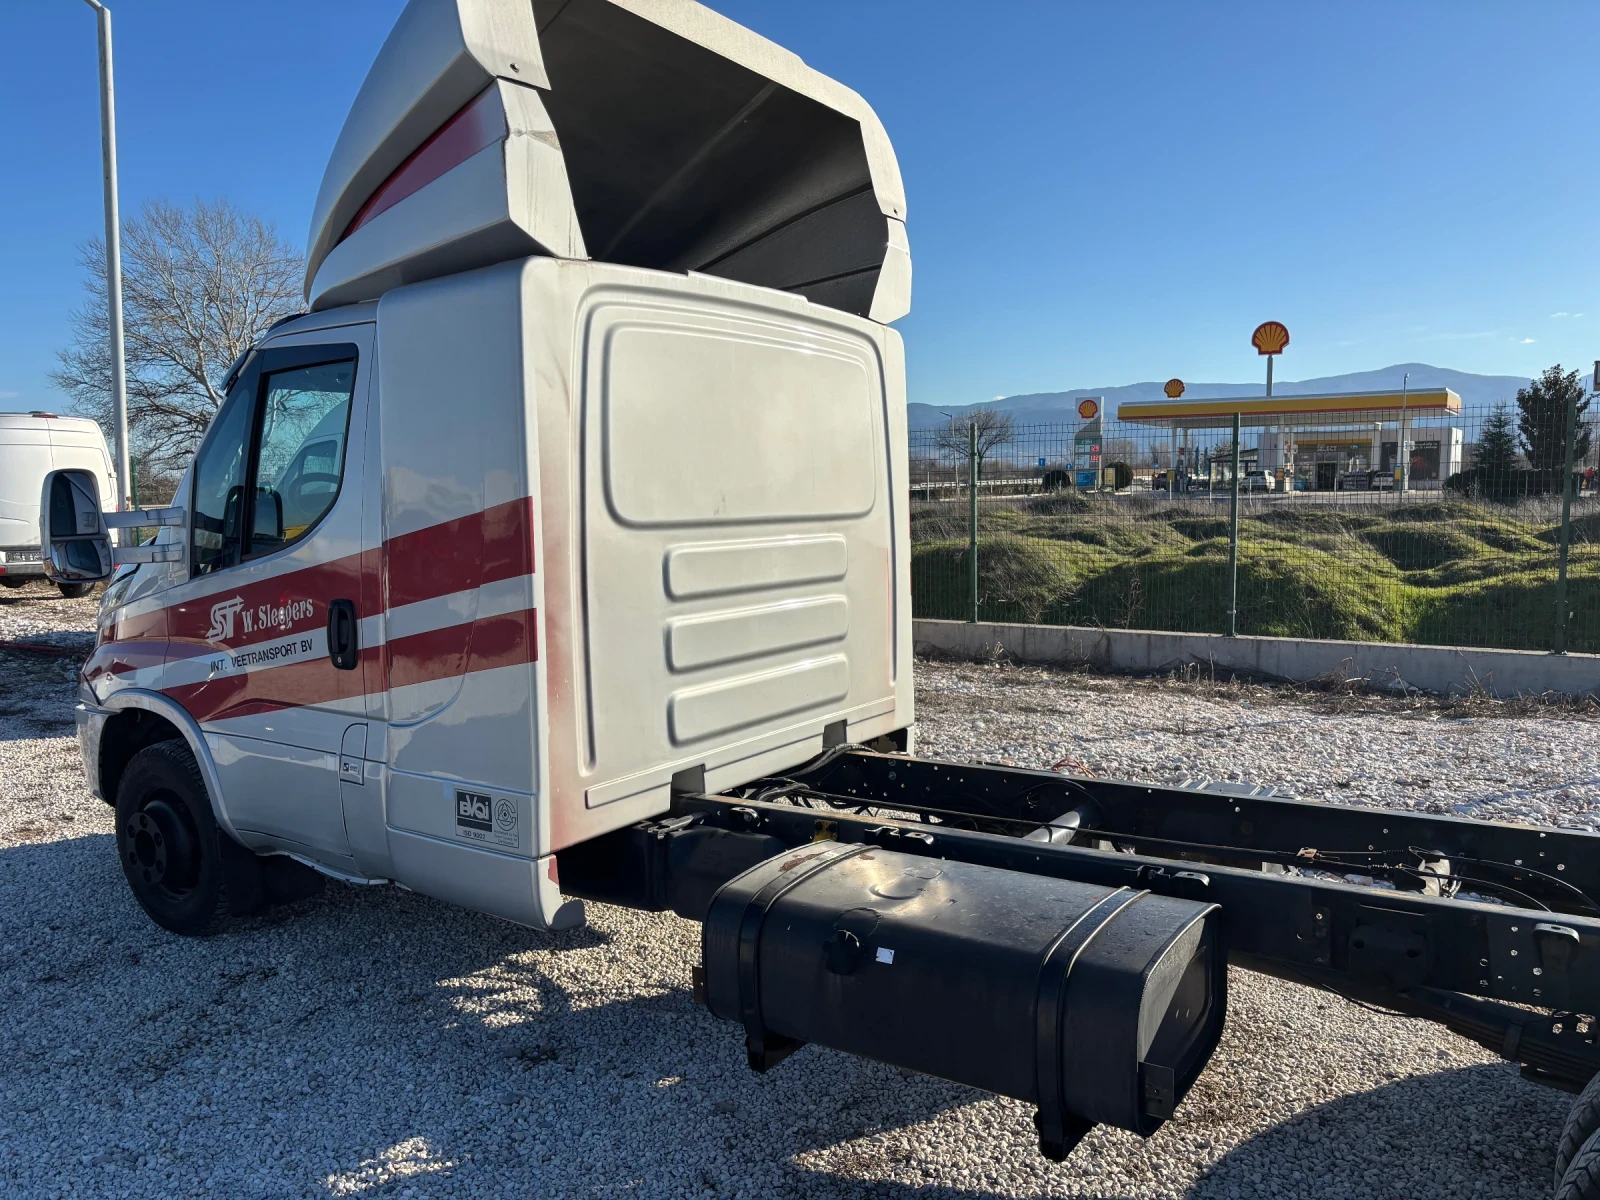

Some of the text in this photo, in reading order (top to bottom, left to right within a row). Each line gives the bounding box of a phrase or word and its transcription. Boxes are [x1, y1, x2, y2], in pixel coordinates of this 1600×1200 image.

[211, 639, 313, 672] INT. VEETRANSPORT BV
